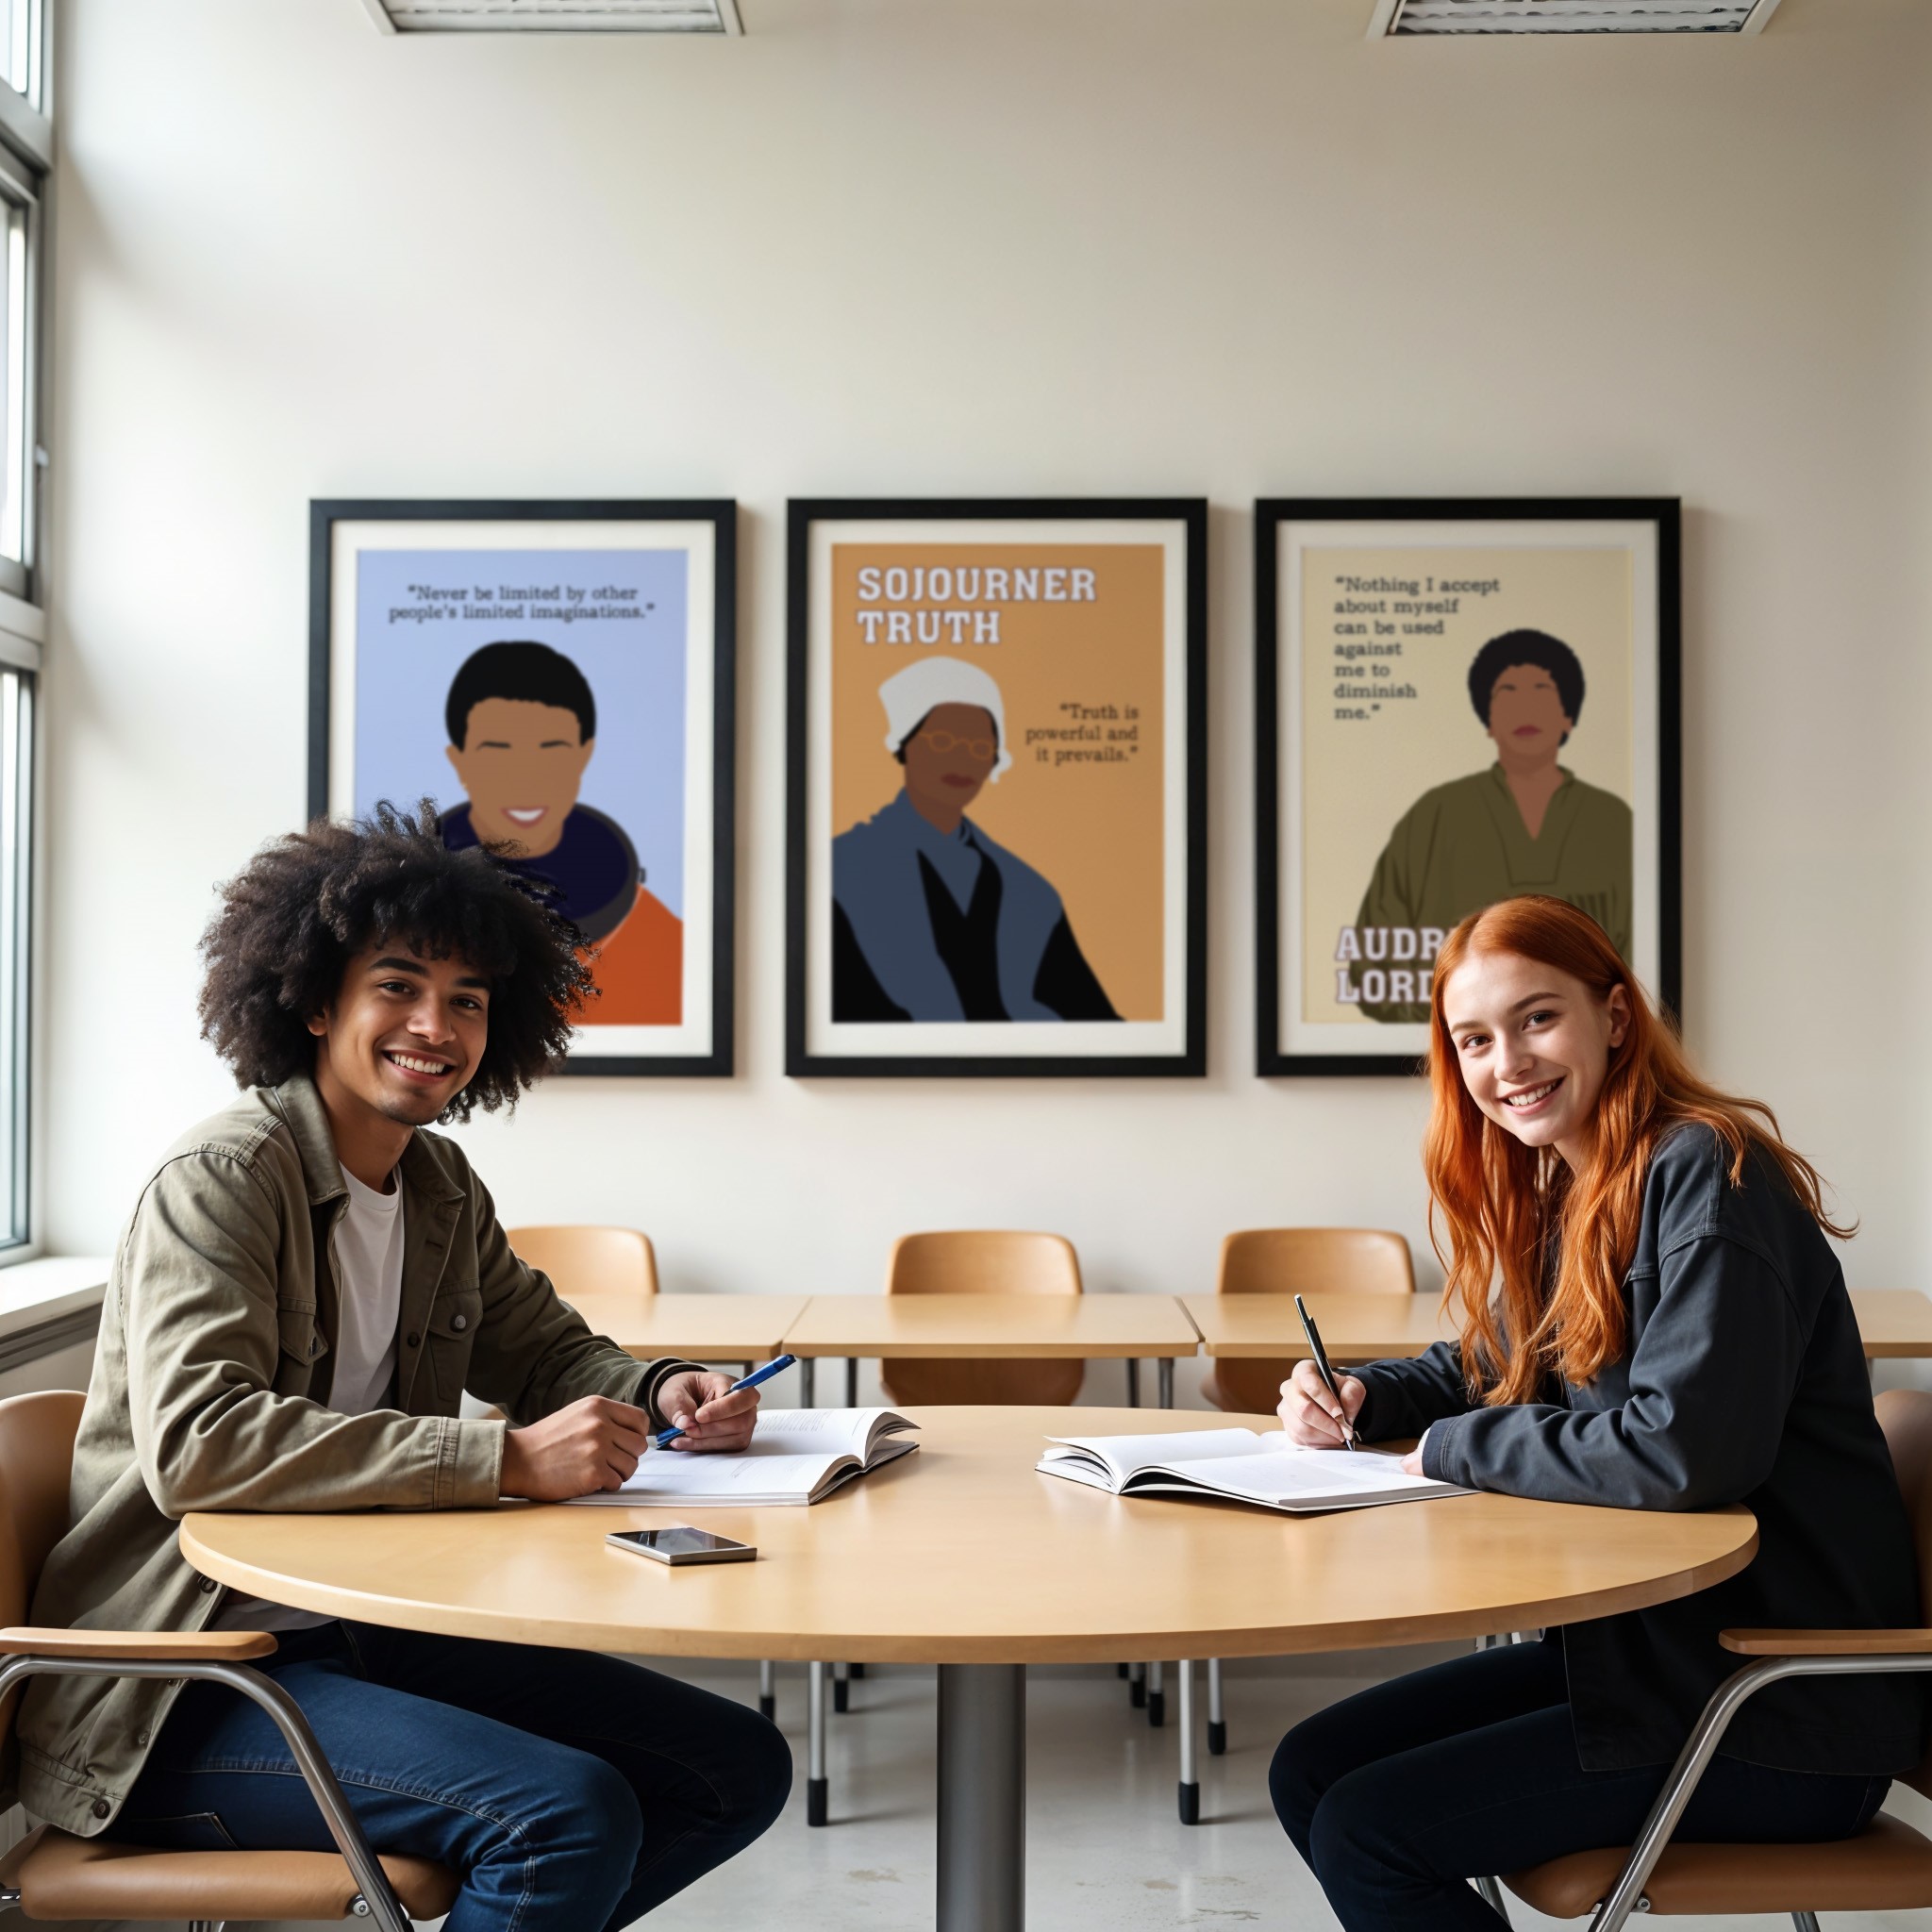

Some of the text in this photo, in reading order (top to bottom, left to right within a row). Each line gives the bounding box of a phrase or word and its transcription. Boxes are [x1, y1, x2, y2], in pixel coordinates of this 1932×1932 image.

[857, 566, 1097, 603] SOJOURNER
[1425, 577, 1434, 592] I
[1440, 578, 1501, 596] accept
[474, 585, 493, 601] be
[498, 585, 561, 601] limited
[566, 585, 587, 604] by
[591, 585, 639, 601] other
[389, 603, 458, 624] people's
[462, 603, 525, 620] limited
[1334, 598, 1459, 617] about myself
[856, 609, 1001, 644] TRUTH
[1334, 619, 1445, 635] can be used
[1334, 641, 1403, 660] against
[1334, 663, 1391, 677] me to
[1334, 683, 1417, 699] diminish
[1124, 705, 1140, 720] is
[1025, 724, 1139, 745] powerful and
[1036, 746, 1049, 762] it
[1334, 925, 1454, 961] AUDR
[1335, 968, 1434, 1004] LORD
